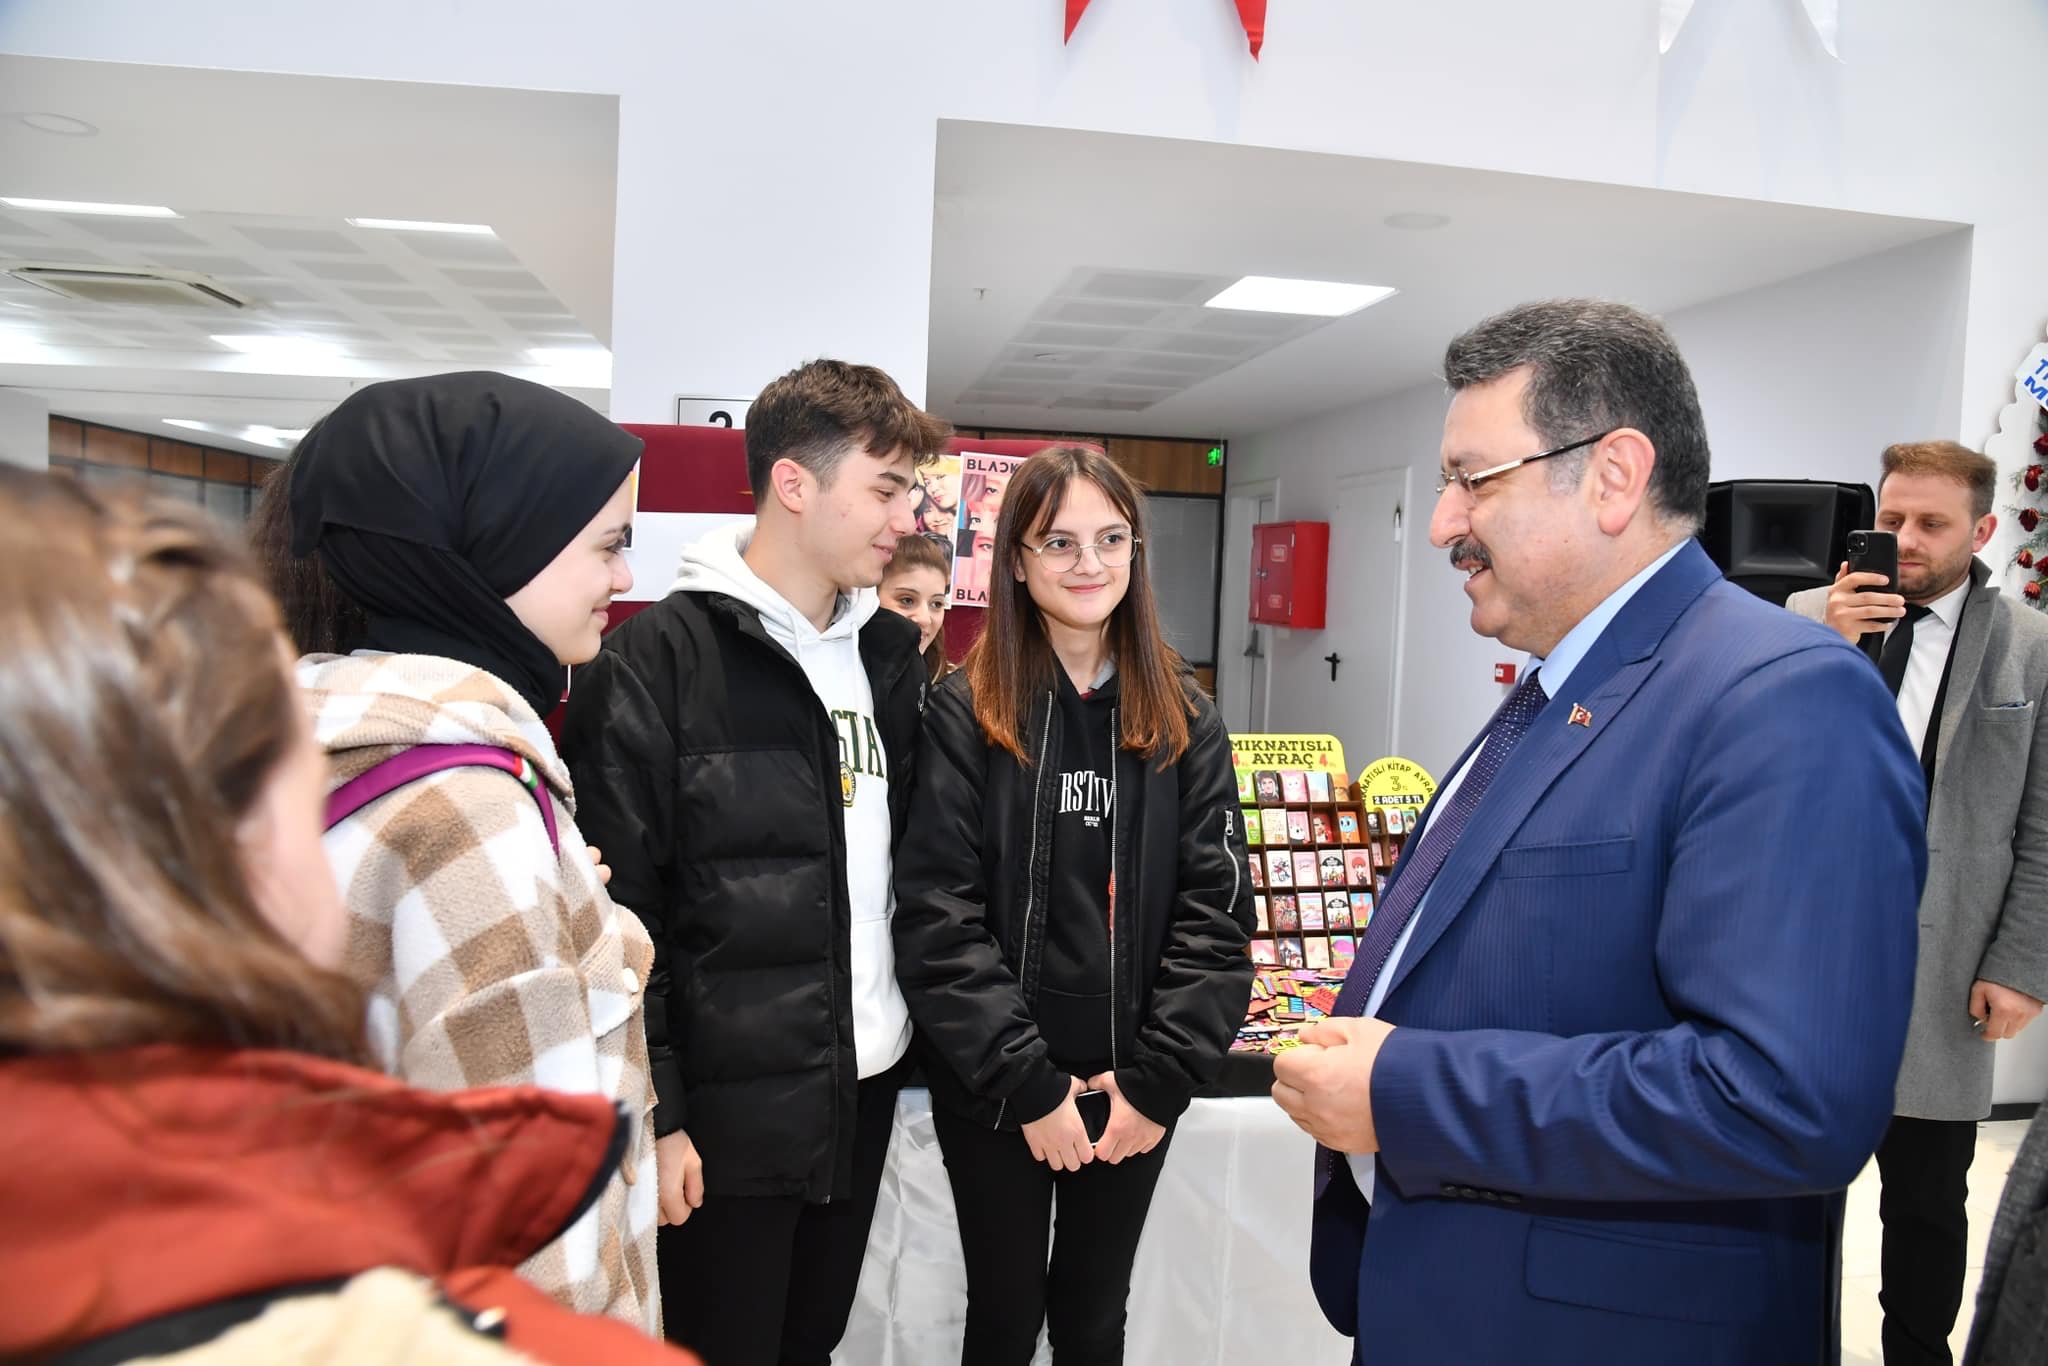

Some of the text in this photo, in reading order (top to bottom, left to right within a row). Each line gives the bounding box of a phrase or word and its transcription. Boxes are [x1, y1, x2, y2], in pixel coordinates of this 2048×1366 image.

[1252, 753, 1314, 769] AYRAÇ
[1387, 760, 1411, 773] KİTAP
[1390, 776, 1401, 791] 3
[1374, 796, 1380, 804] 2
[1381, 796, 1404, 804] ADET
[1412, 796, 1422, 804] TL
